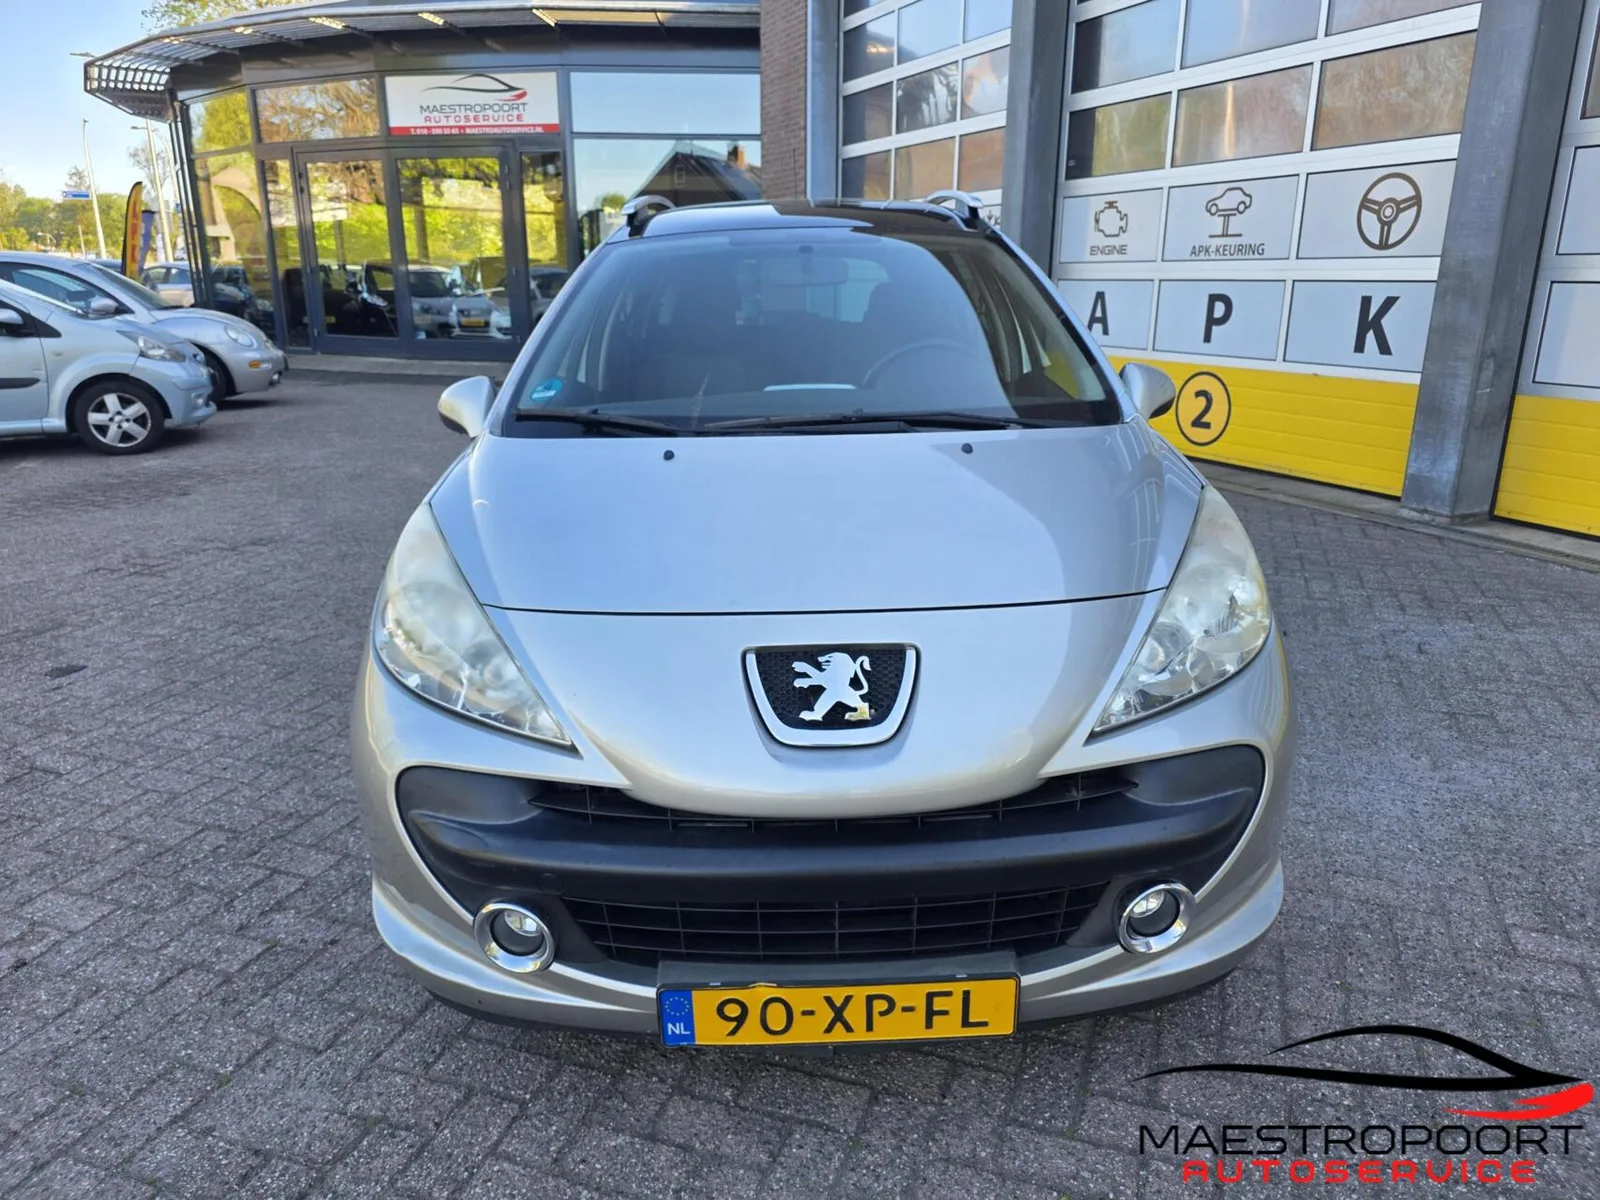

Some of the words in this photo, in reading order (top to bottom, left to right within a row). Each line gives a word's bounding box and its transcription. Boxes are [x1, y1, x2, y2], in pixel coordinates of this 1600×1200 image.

[420, 103, 528, 114] MAESTROPOORT
[424, 114, 524, 123] AUTOSERVICE
[1089, 244, 1128, 256] ENGINE
[1189, 243, 1265, 257] APK-KEURING
[1190, 389, 1213, 429] 2
[667, 1022, 691, 1035] NL
[715, 989, 989, 1037] 90-XP-FL
